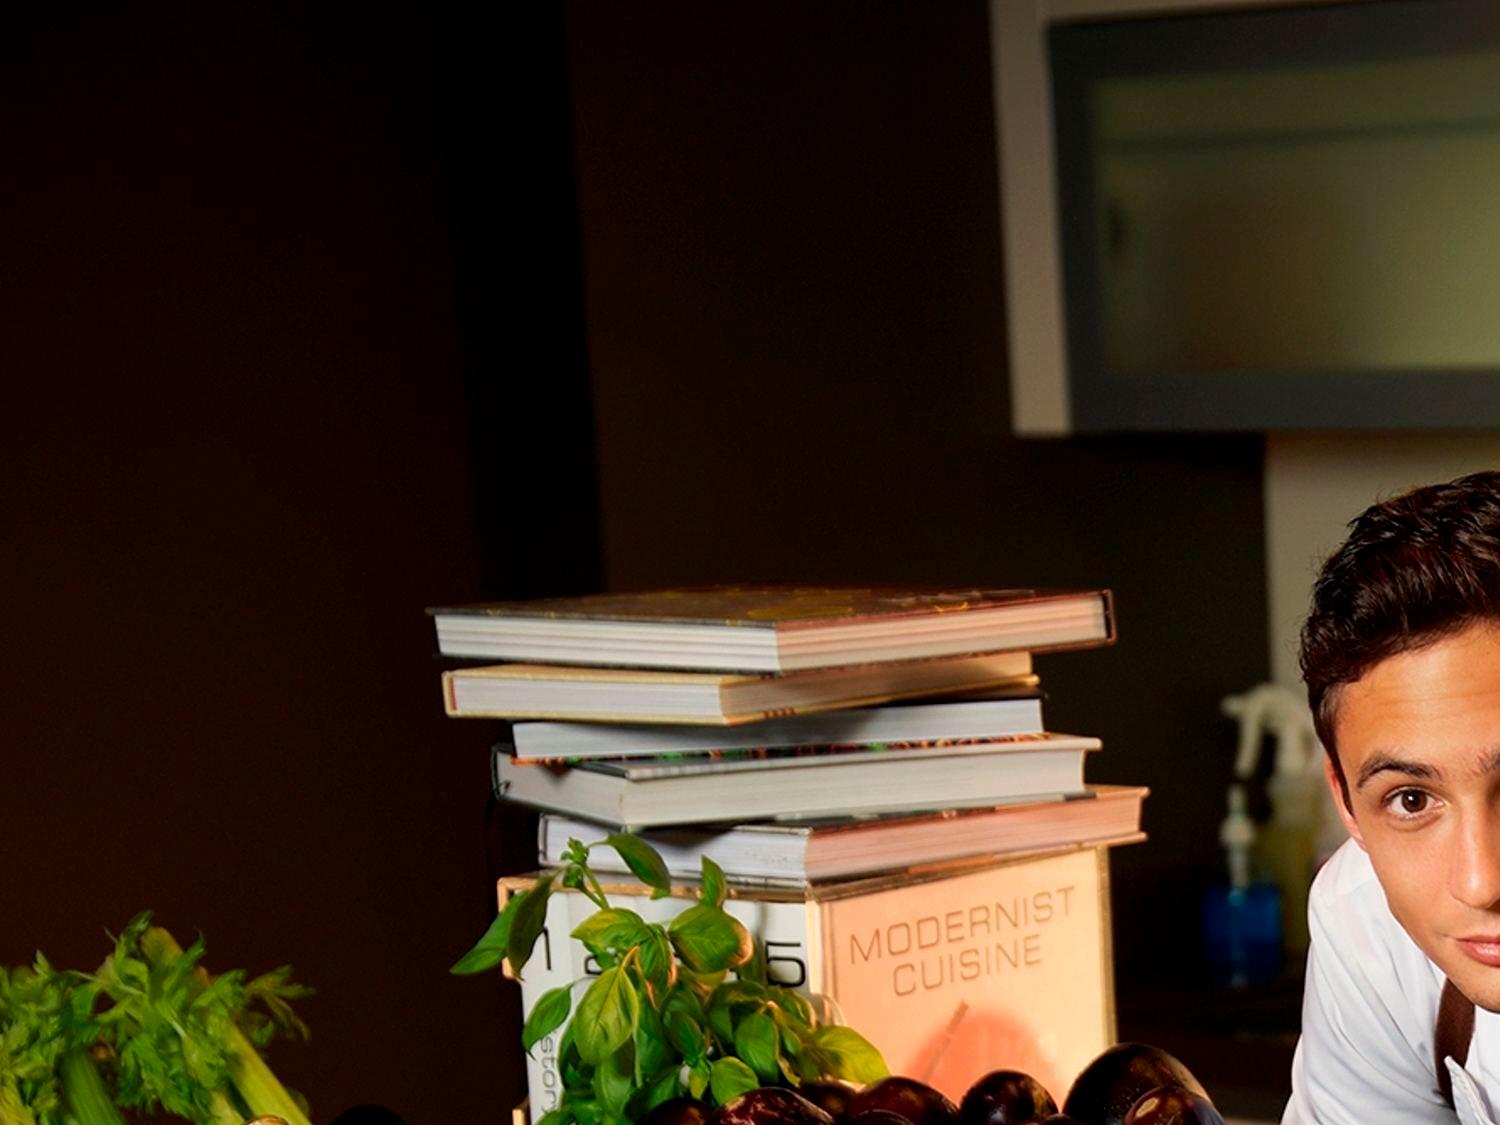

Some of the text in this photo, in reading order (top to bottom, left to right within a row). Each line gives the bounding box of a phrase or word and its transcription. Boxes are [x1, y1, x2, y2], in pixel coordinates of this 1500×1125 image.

[849, 885, 1075, 965] MODERNIST
[764, 941, 806, 989] 5
[892, 933, 1042, 996] CUISINE
